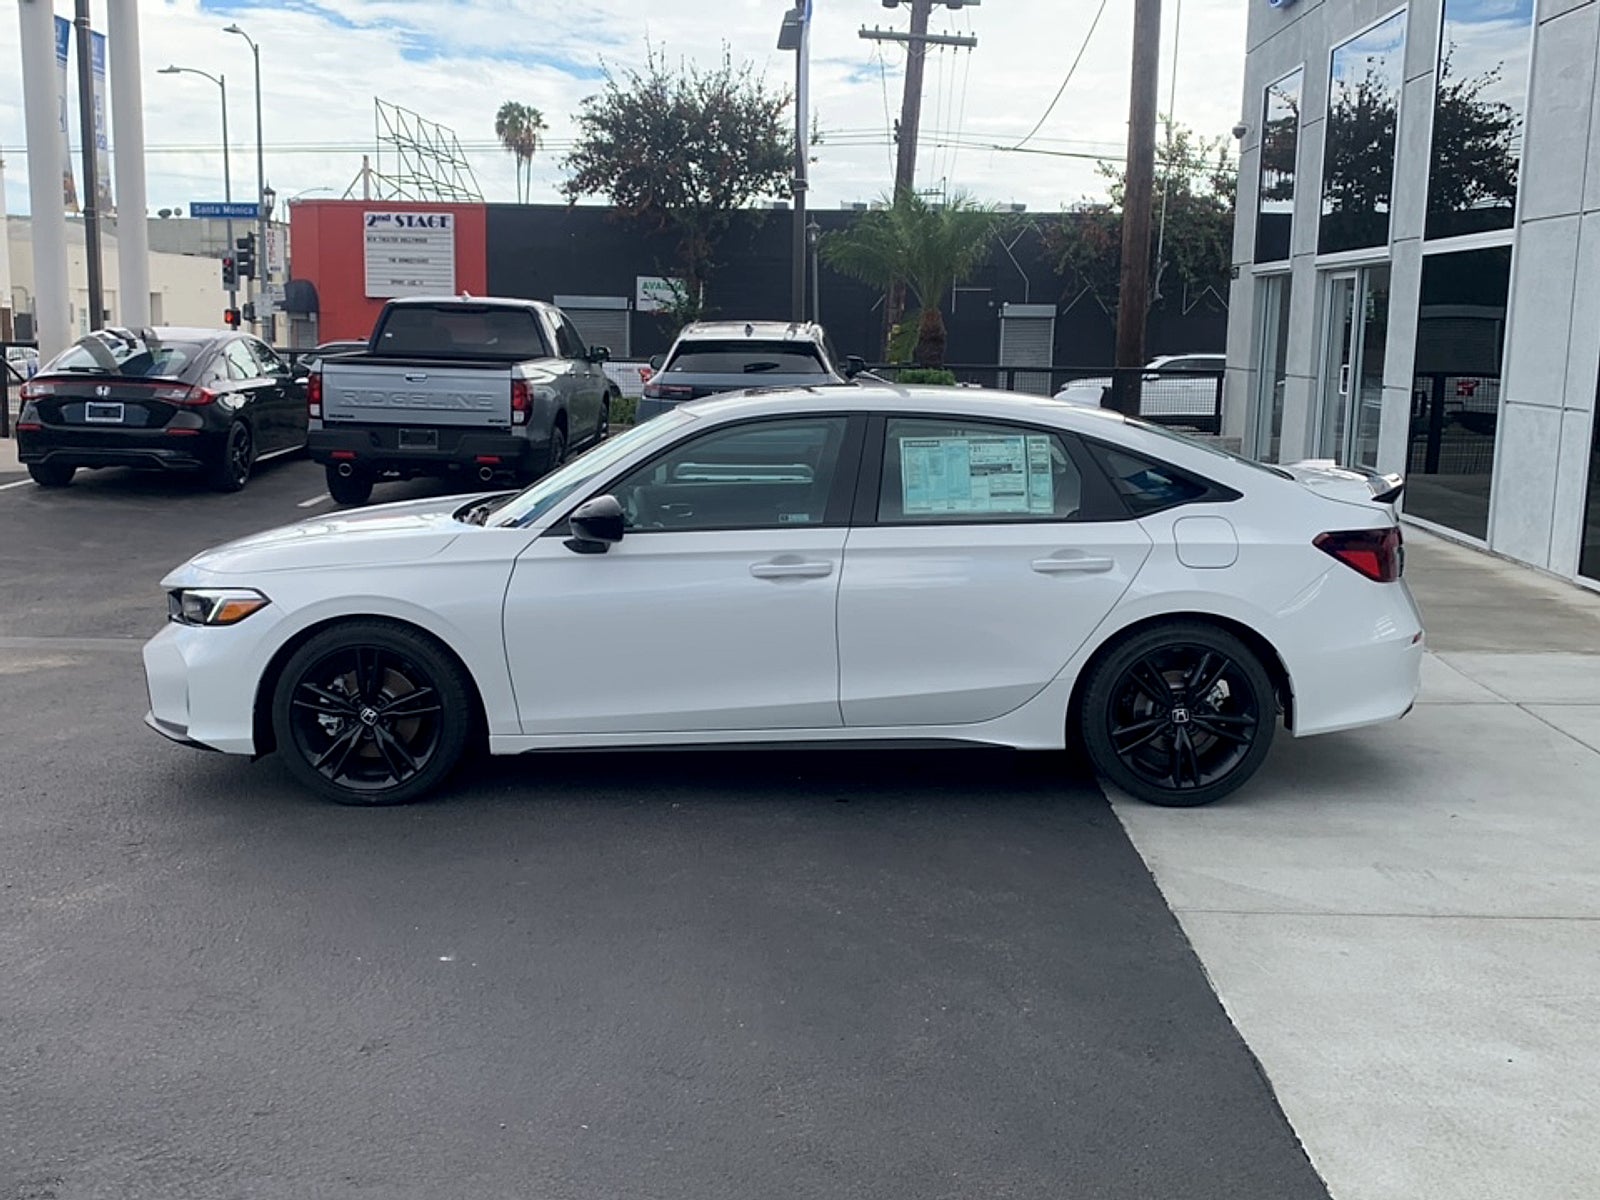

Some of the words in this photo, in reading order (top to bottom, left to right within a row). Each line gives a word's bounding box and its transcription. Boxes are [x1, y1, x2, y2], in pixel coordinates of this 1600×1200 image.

[193, 204, 220, 214] Santa
[222, 205, 255, 214] Monica
[367, 213, 391, 227] 2nd
[395, 214, 450, 228] STAGE
[341, 390, 494, 410] RIDGELINE
